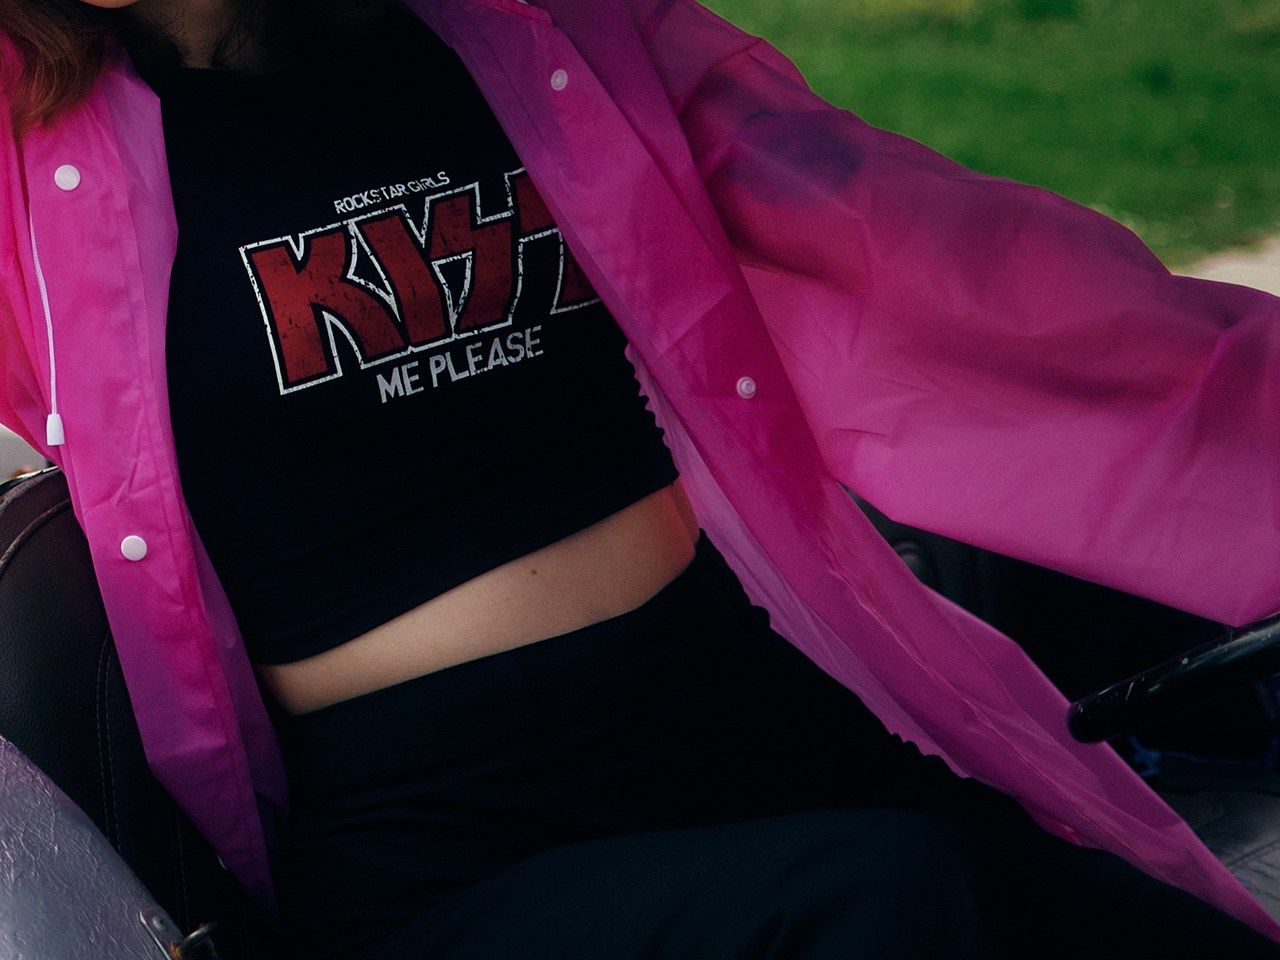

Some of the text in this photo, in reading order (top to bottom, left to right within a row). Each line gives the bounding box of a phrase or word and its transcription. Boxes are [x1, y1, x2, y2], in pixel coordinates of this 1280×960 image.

[333, 171, 451, 214] ROCKSTAR GIRLS
[376, 324, 544, 404] ME PLEASE
